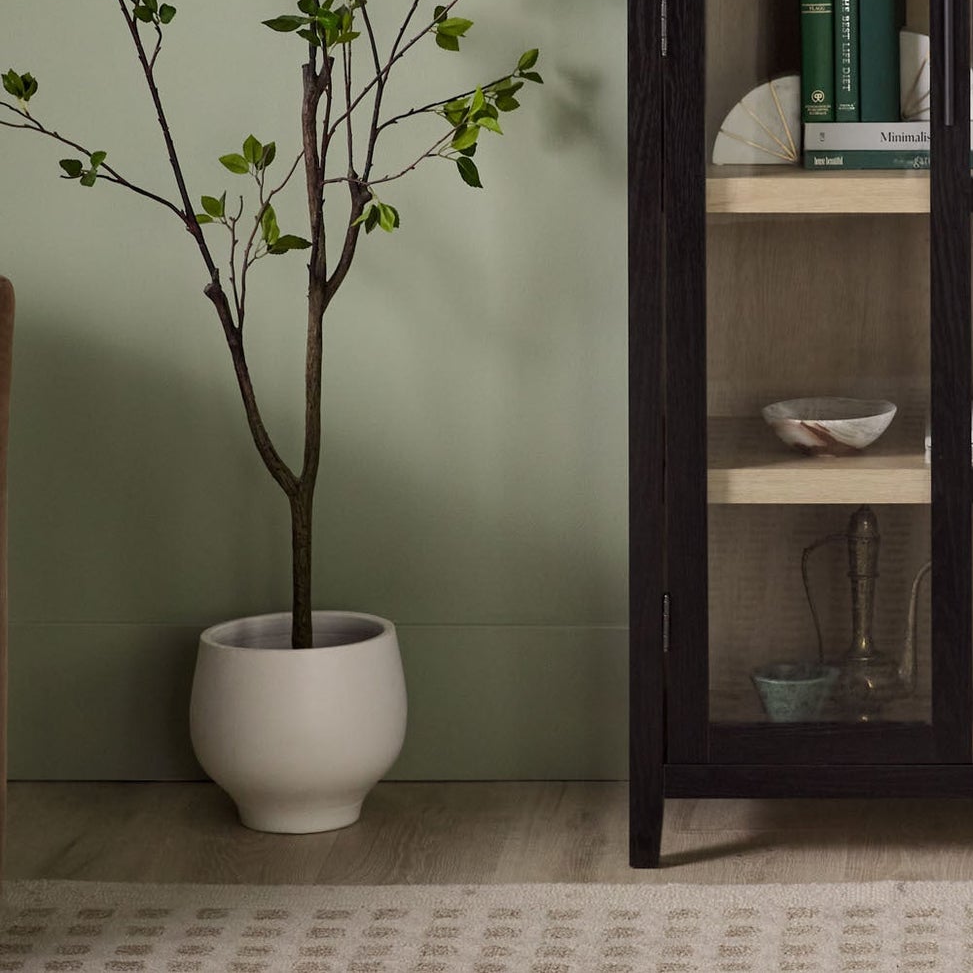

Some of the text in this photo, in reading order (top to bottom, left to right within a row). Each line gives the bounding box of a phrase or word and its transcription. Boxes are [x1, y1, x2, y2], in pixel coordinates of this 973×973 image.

[841, 15, 851, 40] BEST
[842, 42, 851, 65] LIFE
[842, 67, 851, 92] DIET
